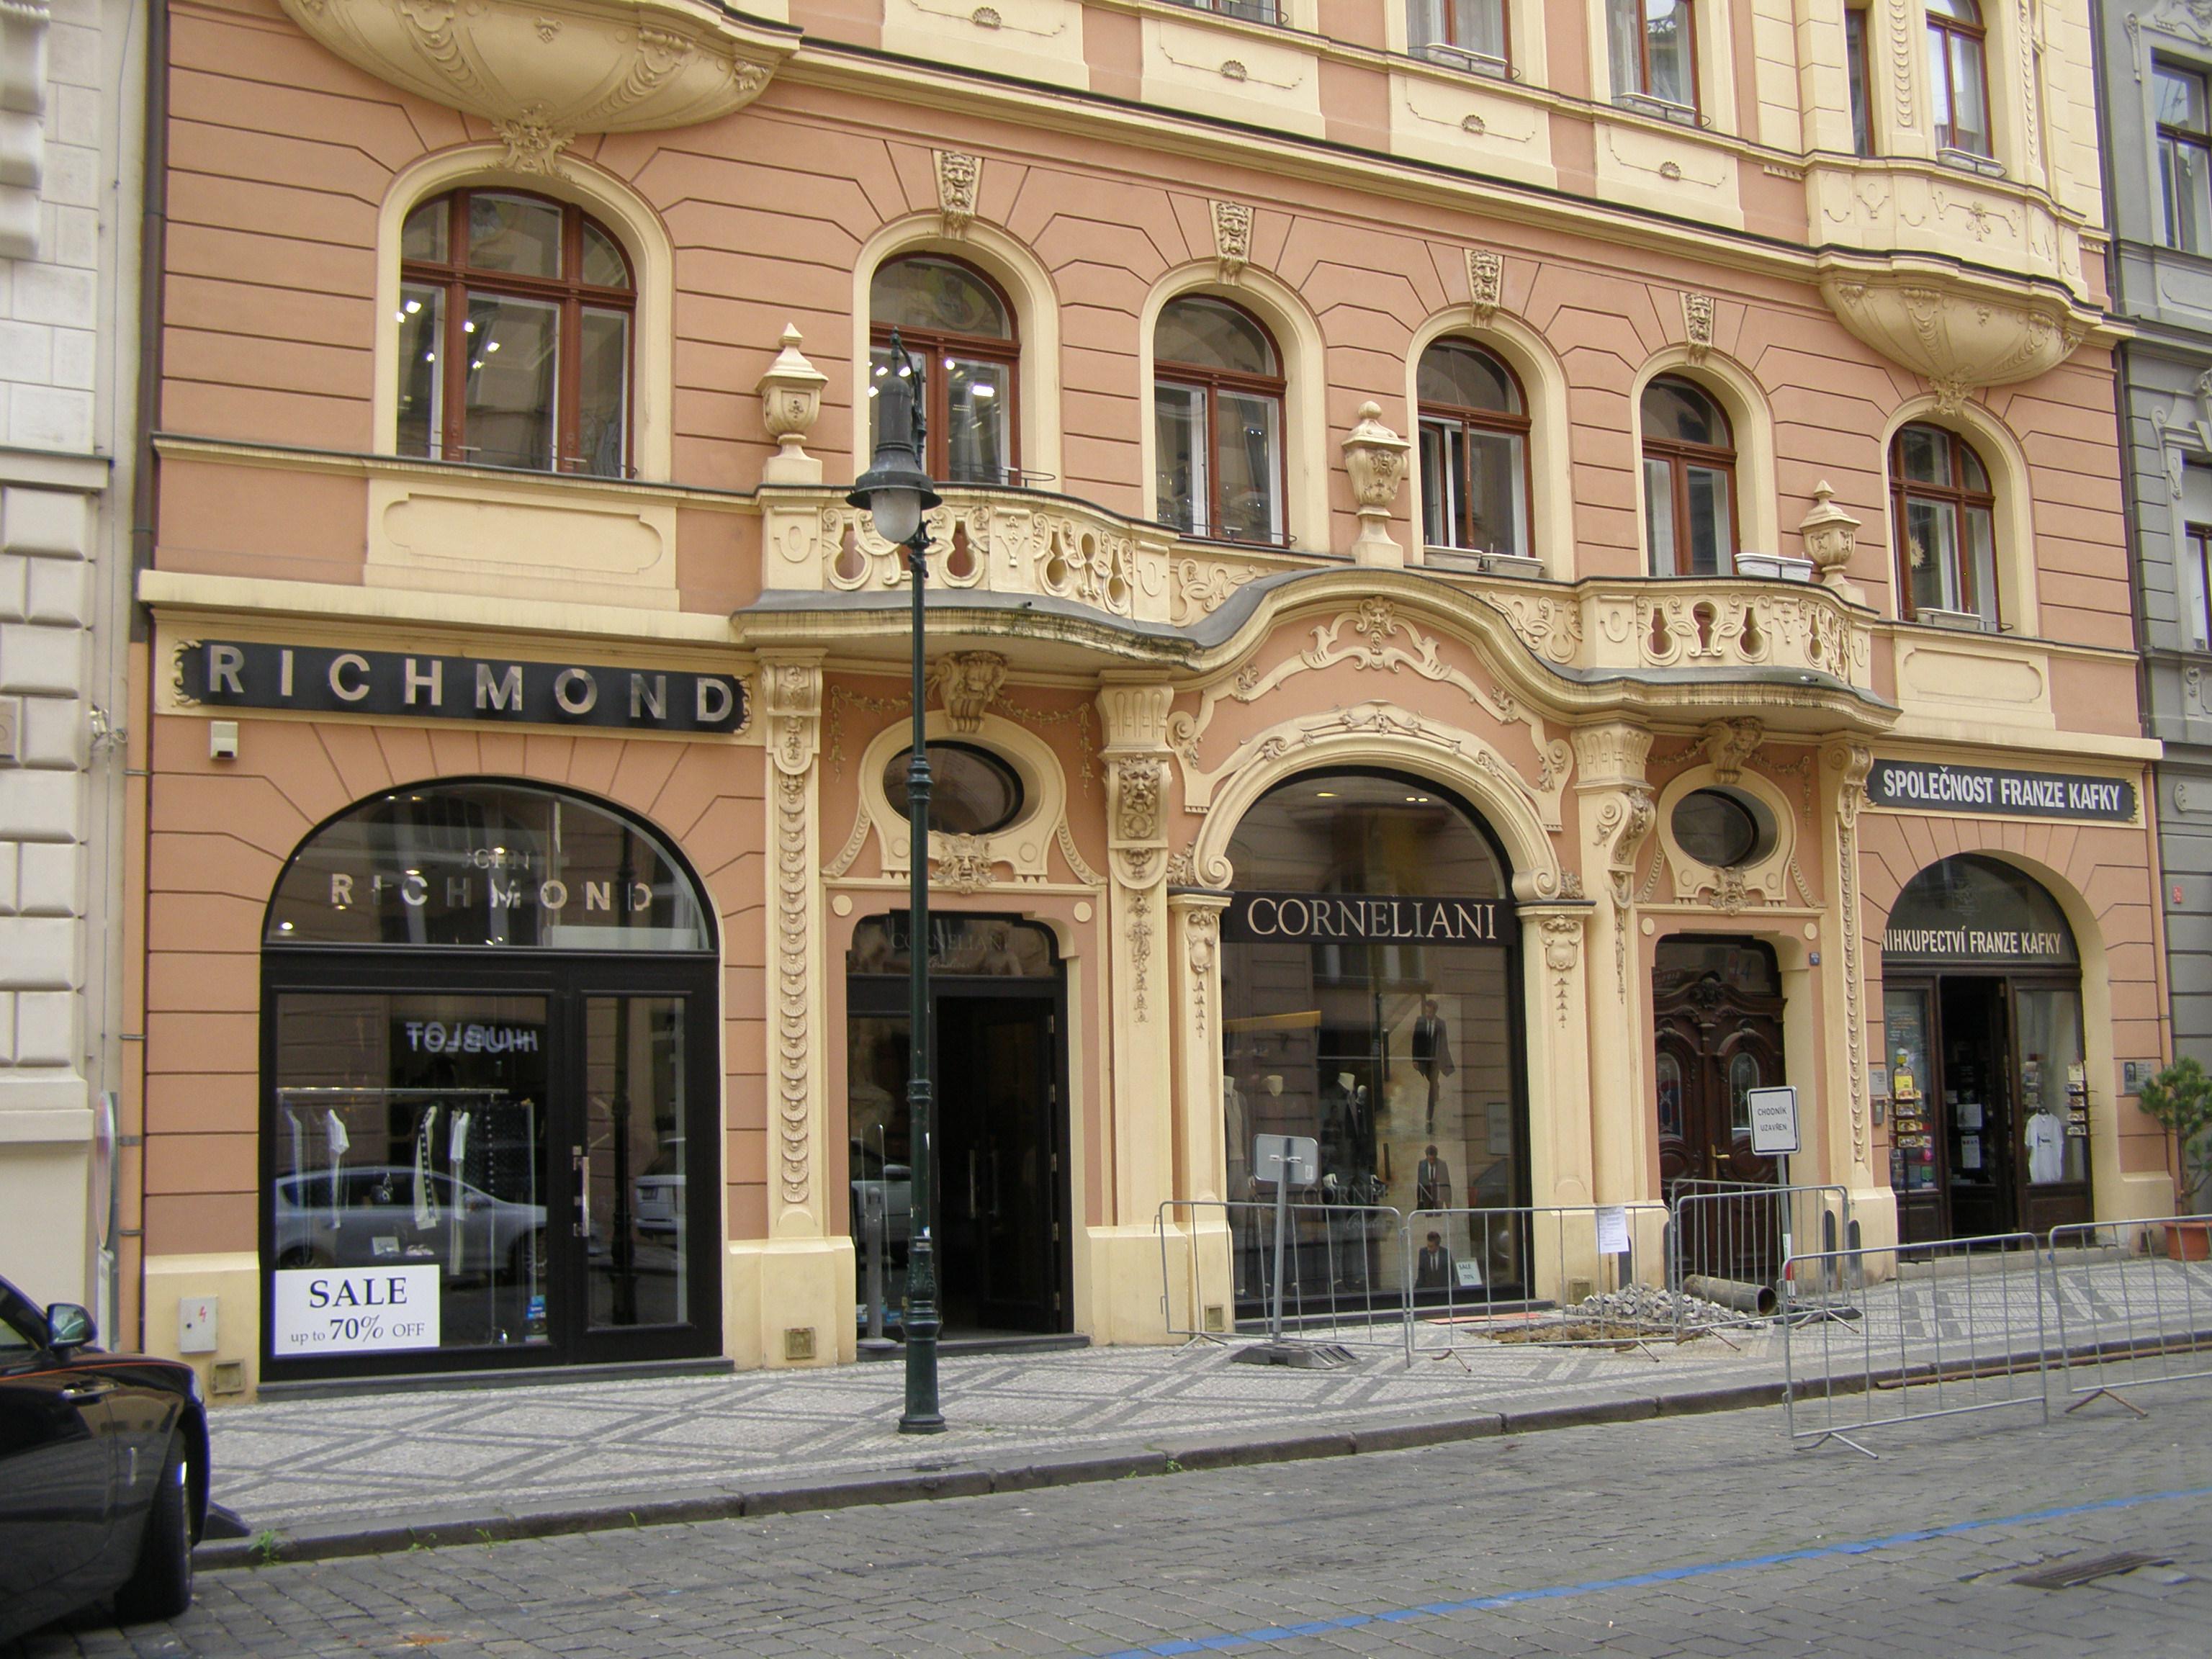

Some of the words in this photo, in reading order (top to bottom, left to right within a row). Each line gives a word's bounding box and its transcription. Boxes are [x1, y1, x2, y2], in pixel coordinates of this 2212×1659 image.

[209, 644, 733, 722] RICHMOND
[1883, 766, 1993, 804] SPOLEČNOST
[2000, 778, 2065, 808] FRANZE
[2069, 782, 2120, 811] KAFKY
[331, 873, 652, 912] RICHMOND
[1247, 897, 1497, 940] CORNELIANI
[1881, 925, 1966, 953] NIHKUPECTVÍ
[1970, 930, 2018, 953] FRANZE
[2021, 932, 2062, 955] KAFKY
[1757, 1106, 1787, 1116] CHODNÍK
[310, 1277, 408, 1308] SALE
[291, 1334, 308, 1345] up
[313, 1330, 325, 1341] to
[330, 1314, 384, 1342] 70%
[392, 1322, 425, 1338] OFF
